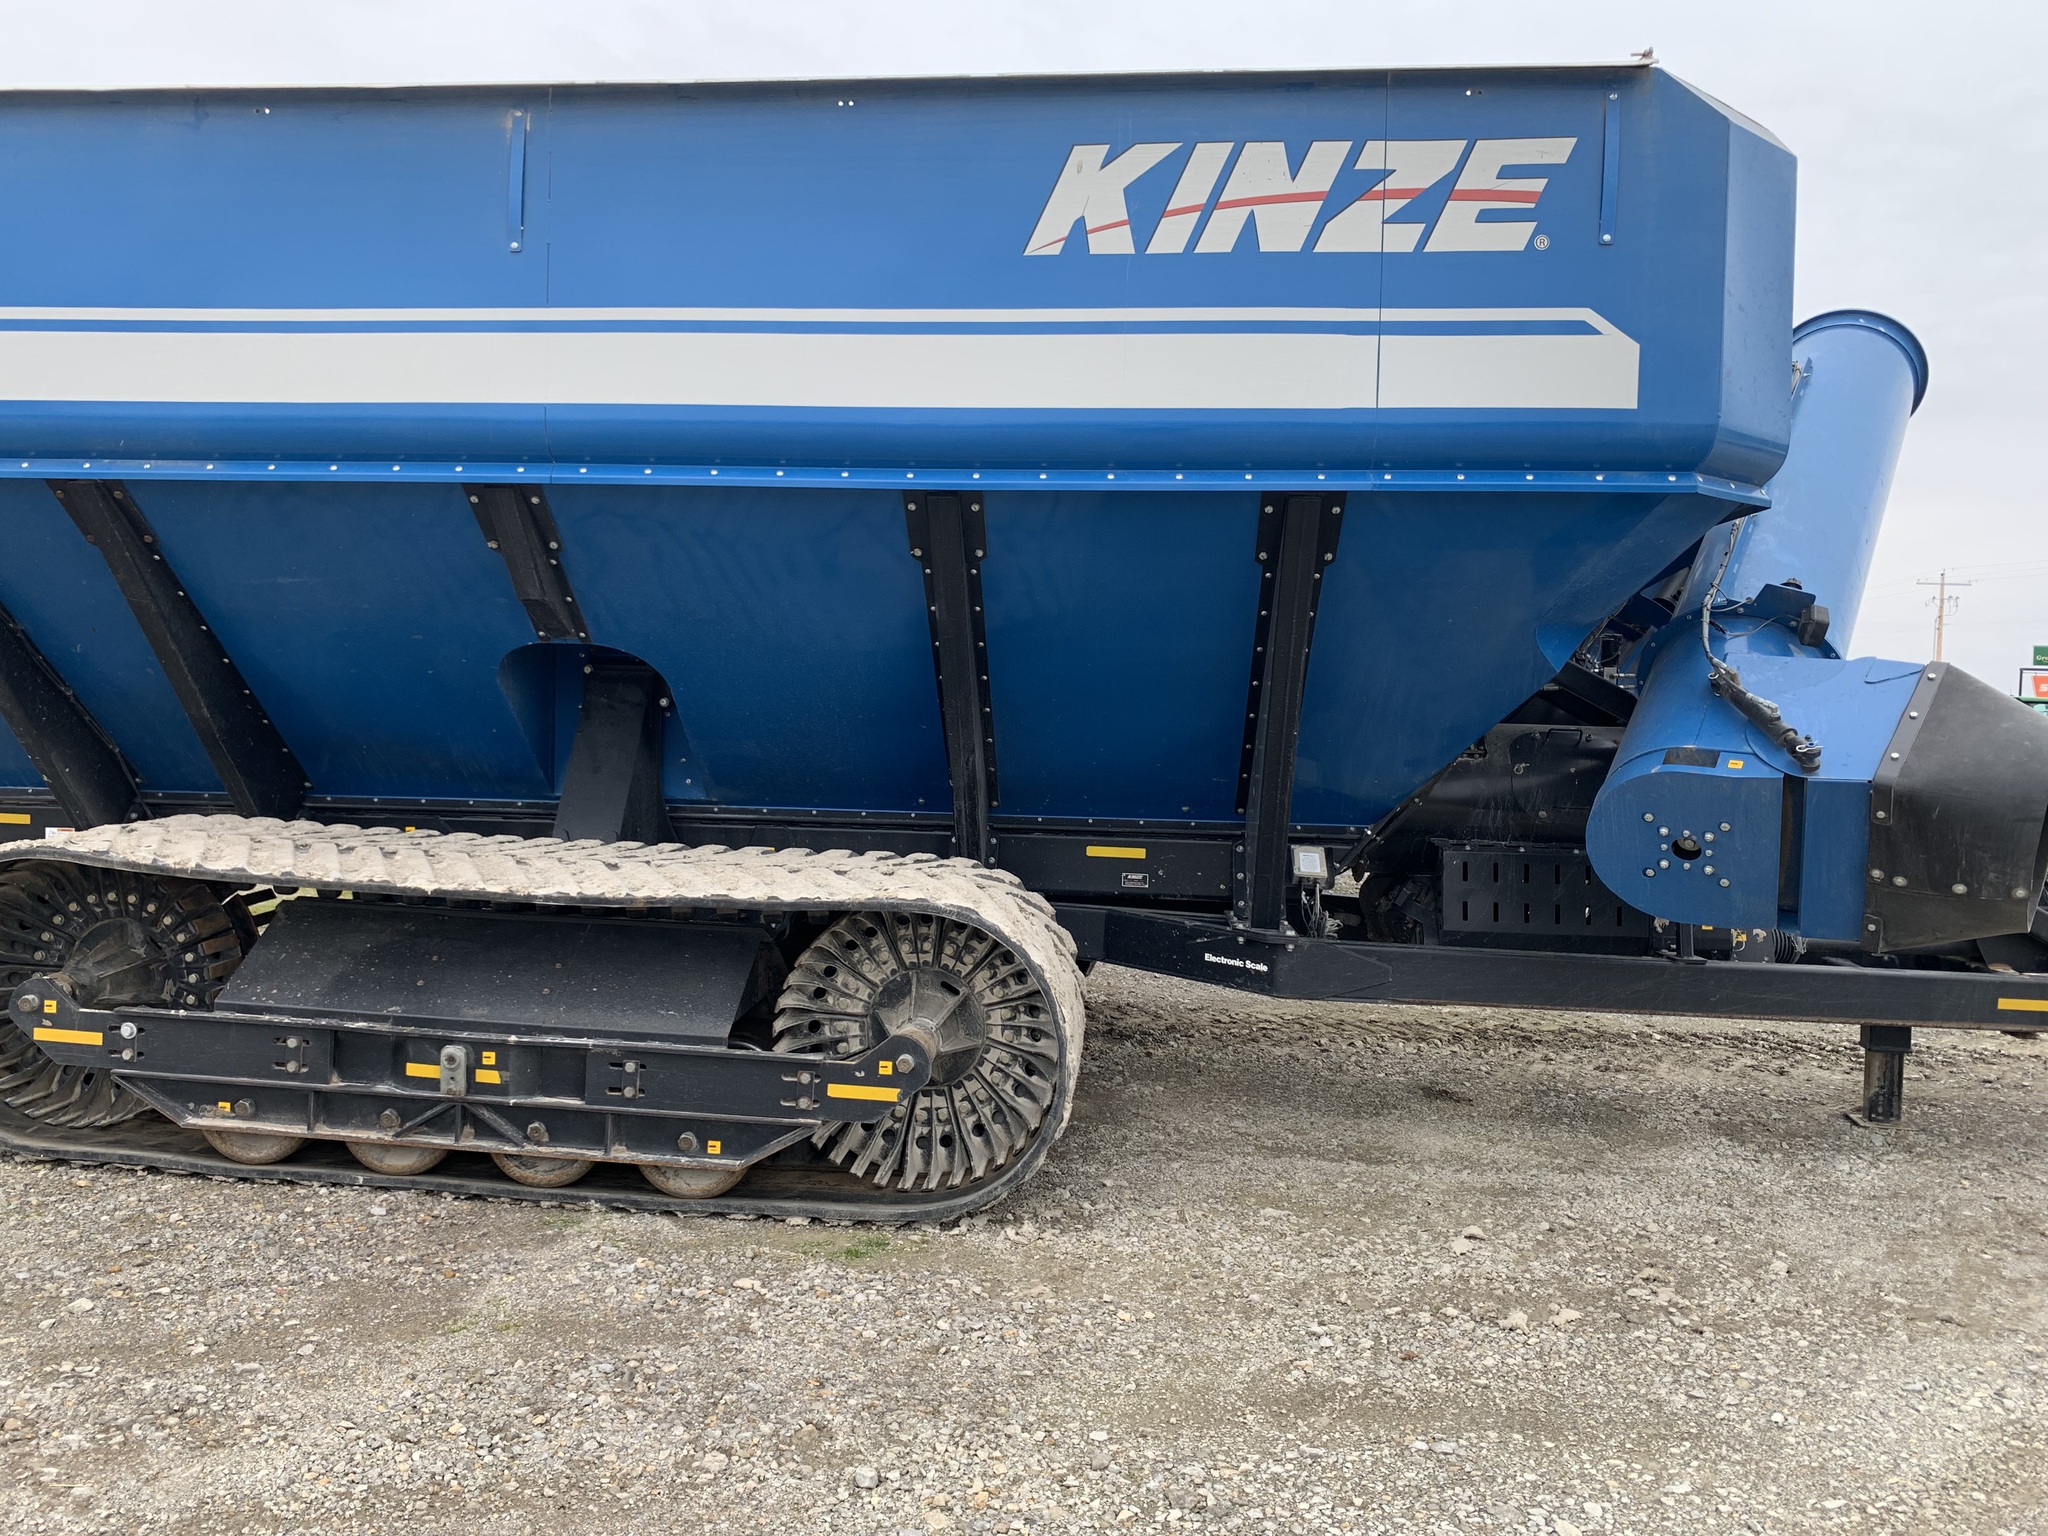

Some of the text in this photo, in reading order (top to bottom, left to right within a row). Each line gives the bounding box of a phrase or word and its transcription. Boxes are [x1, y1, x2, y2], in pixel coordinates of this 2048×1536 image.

[1023, 137, 1578, 256] KINZE
[1204, 953, 1269, 972] Electronic Scale
